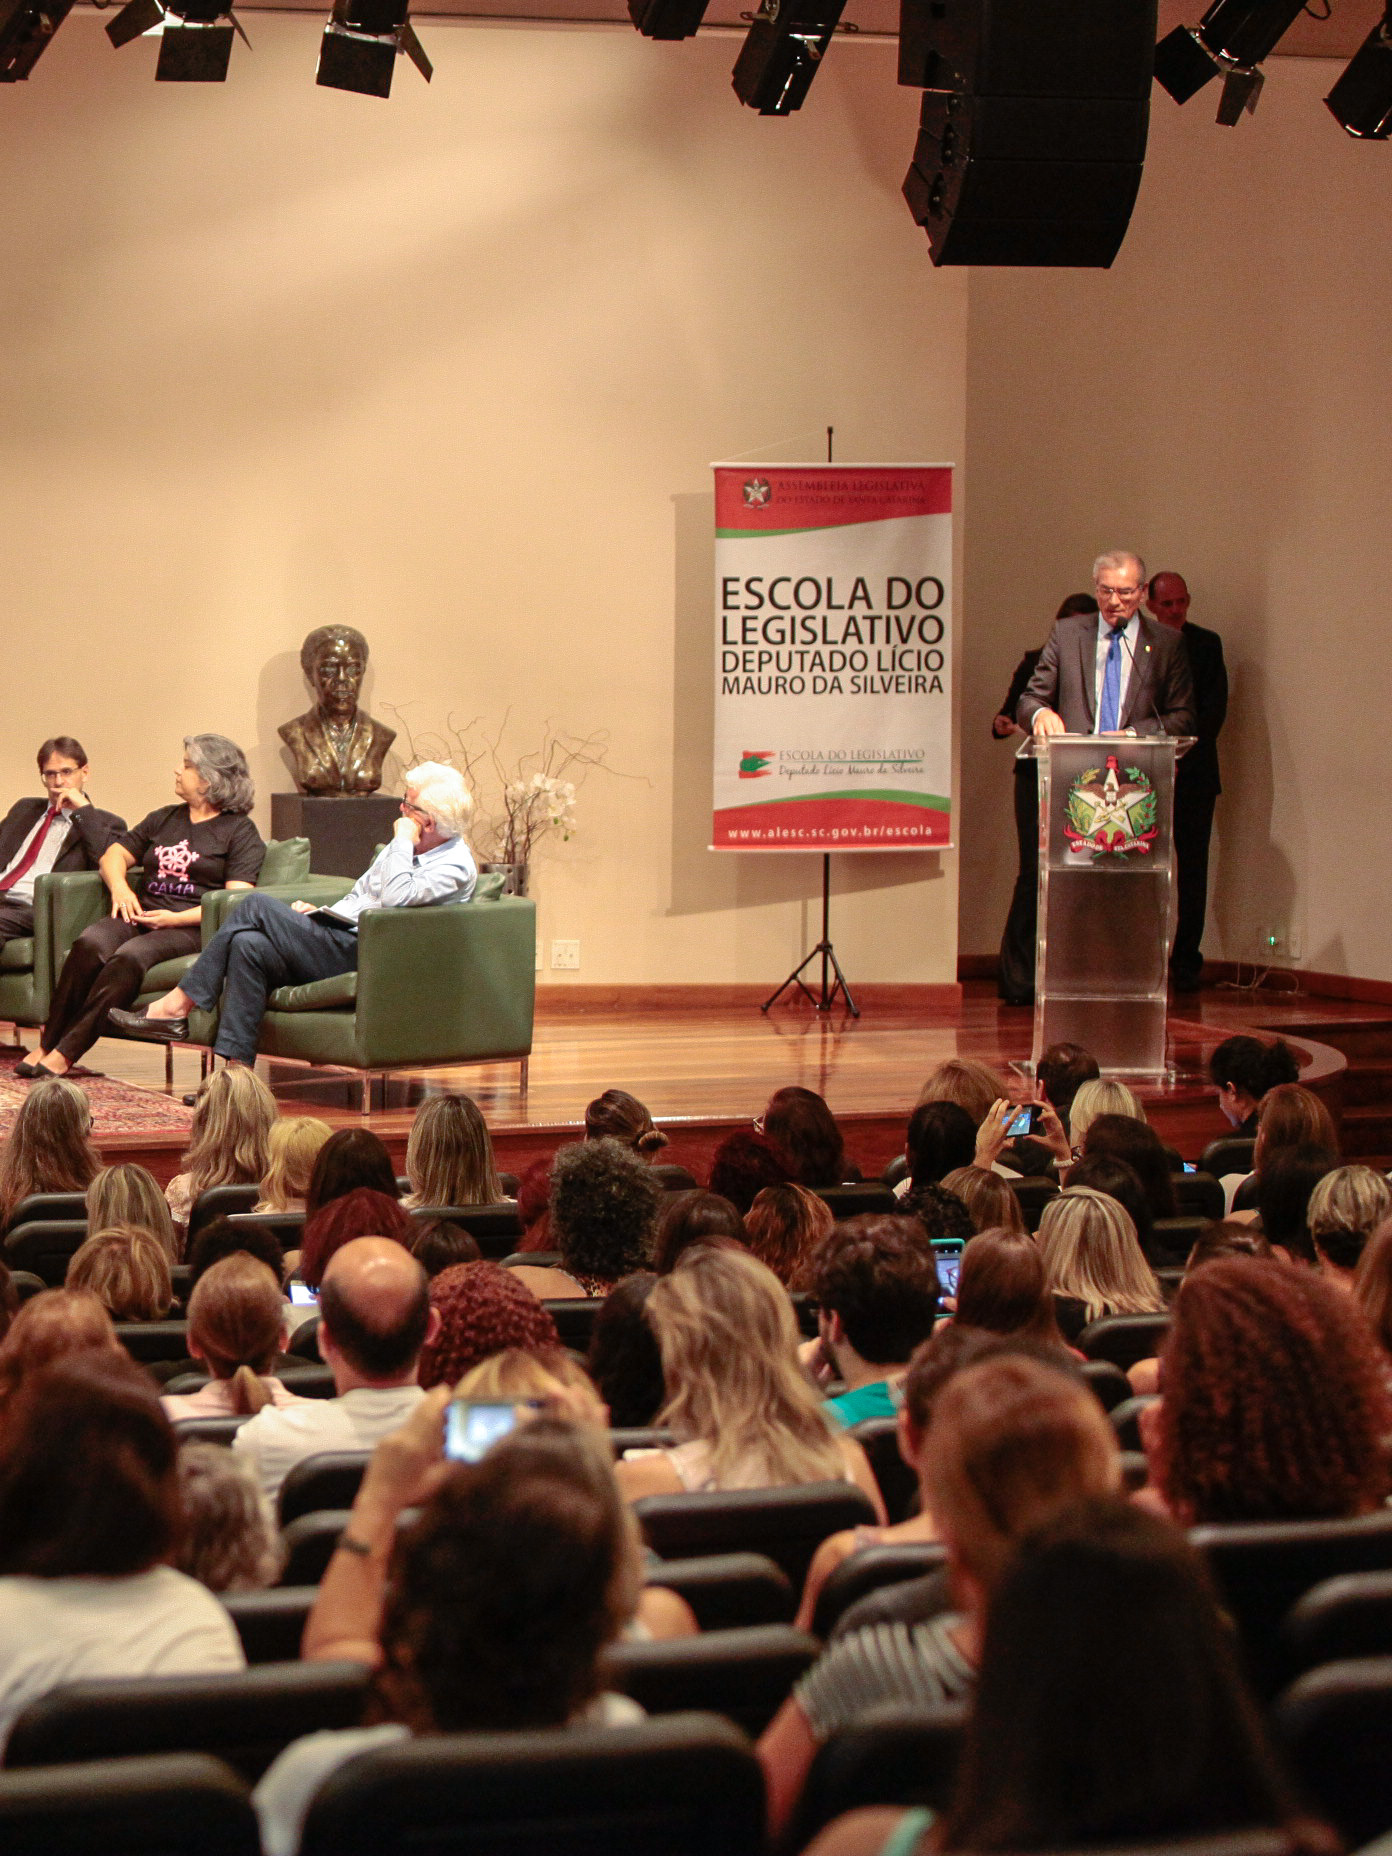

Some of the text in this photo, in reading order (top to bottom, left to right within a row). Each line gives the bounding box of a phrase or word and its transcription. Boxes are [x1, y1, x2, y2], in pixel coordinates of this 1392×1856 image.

[722, 576, 945, 611] ESCOLA DO
[722, 615, 945, 645] LEGISLATIVO
[722, 644, 945, 673] DEPUTADO LÍCIO
[722, 675, 944, 695] MAURO DA SILVEIRA
[779, 749, 925, 760] ESCOLA DO LEGISLATIVO
[779, 764, 820, 780] Deputado
[728, 825, 932, 840] www.alesc.sc.gov.br/escola
